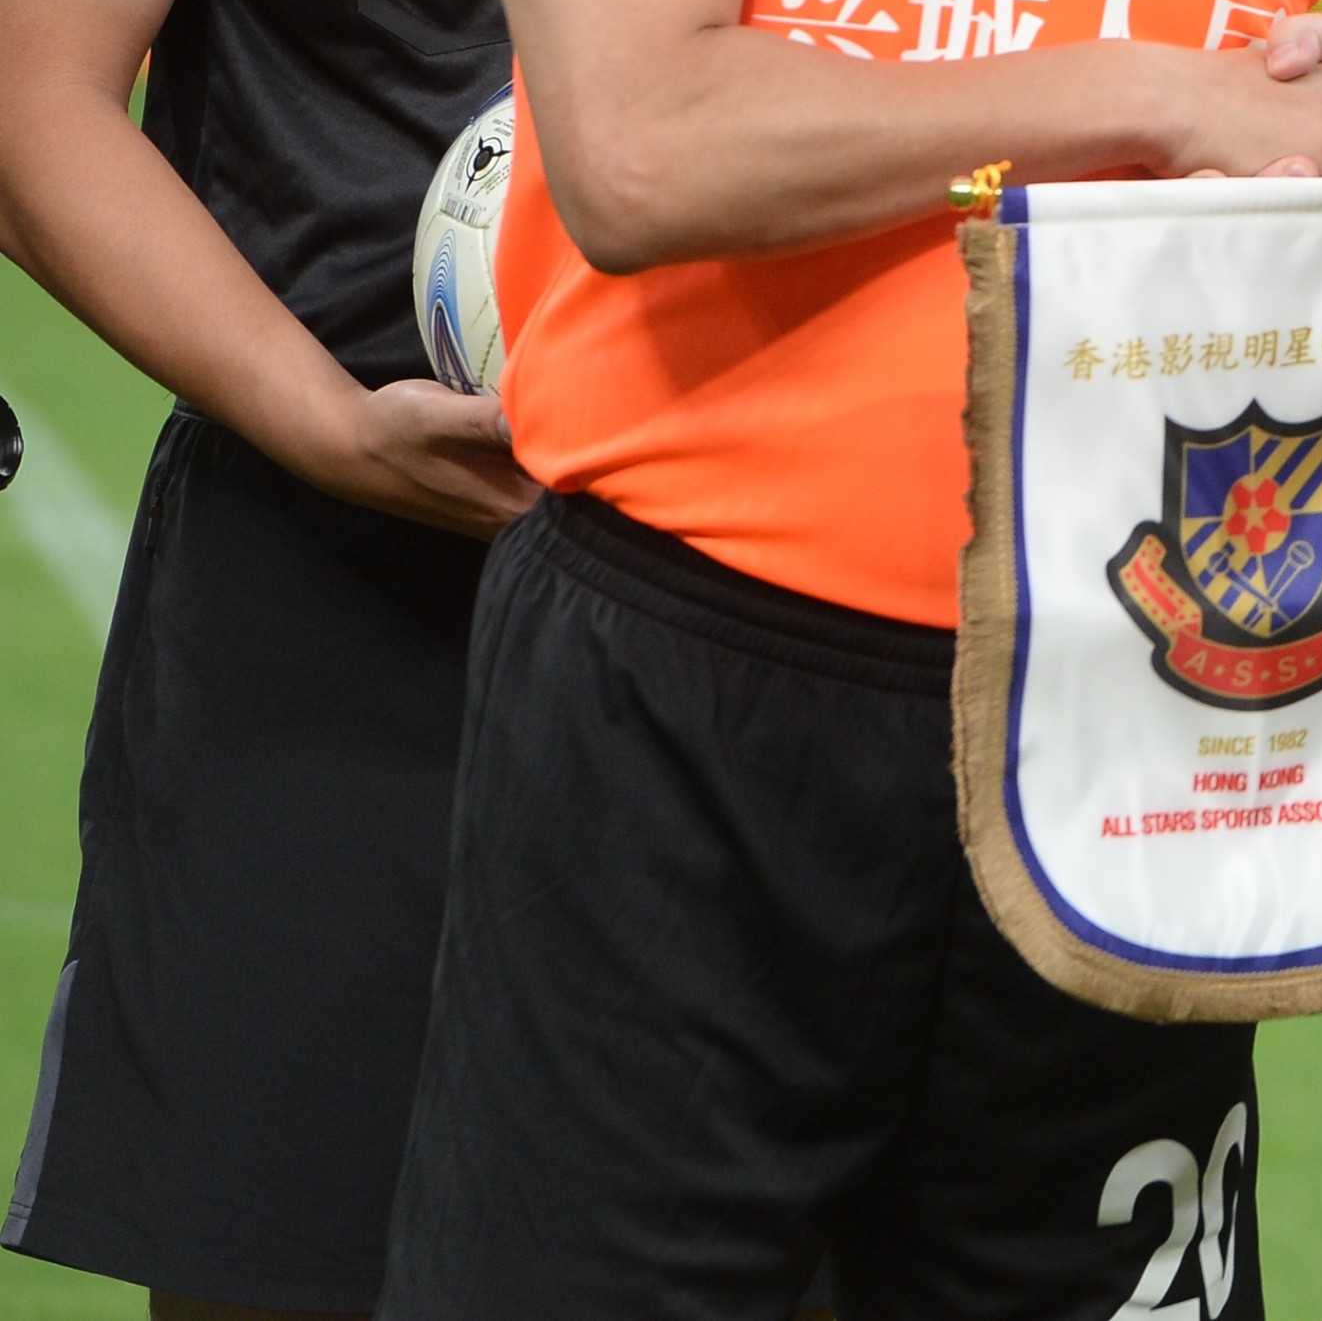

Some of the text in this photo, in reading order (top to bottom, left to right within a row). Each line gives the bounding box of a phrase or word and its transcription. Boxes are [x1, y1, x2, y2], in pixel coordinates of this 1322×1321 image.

[1197, 729, 1308, 757] SINCE 1982
[1192, 764, 1306, 793] HONG KONG
[1101, 815, 1138, 838] ALL
[1141, 810, 1196, 835] STARS
[1201, 805, 1273, 830] SPORTS
